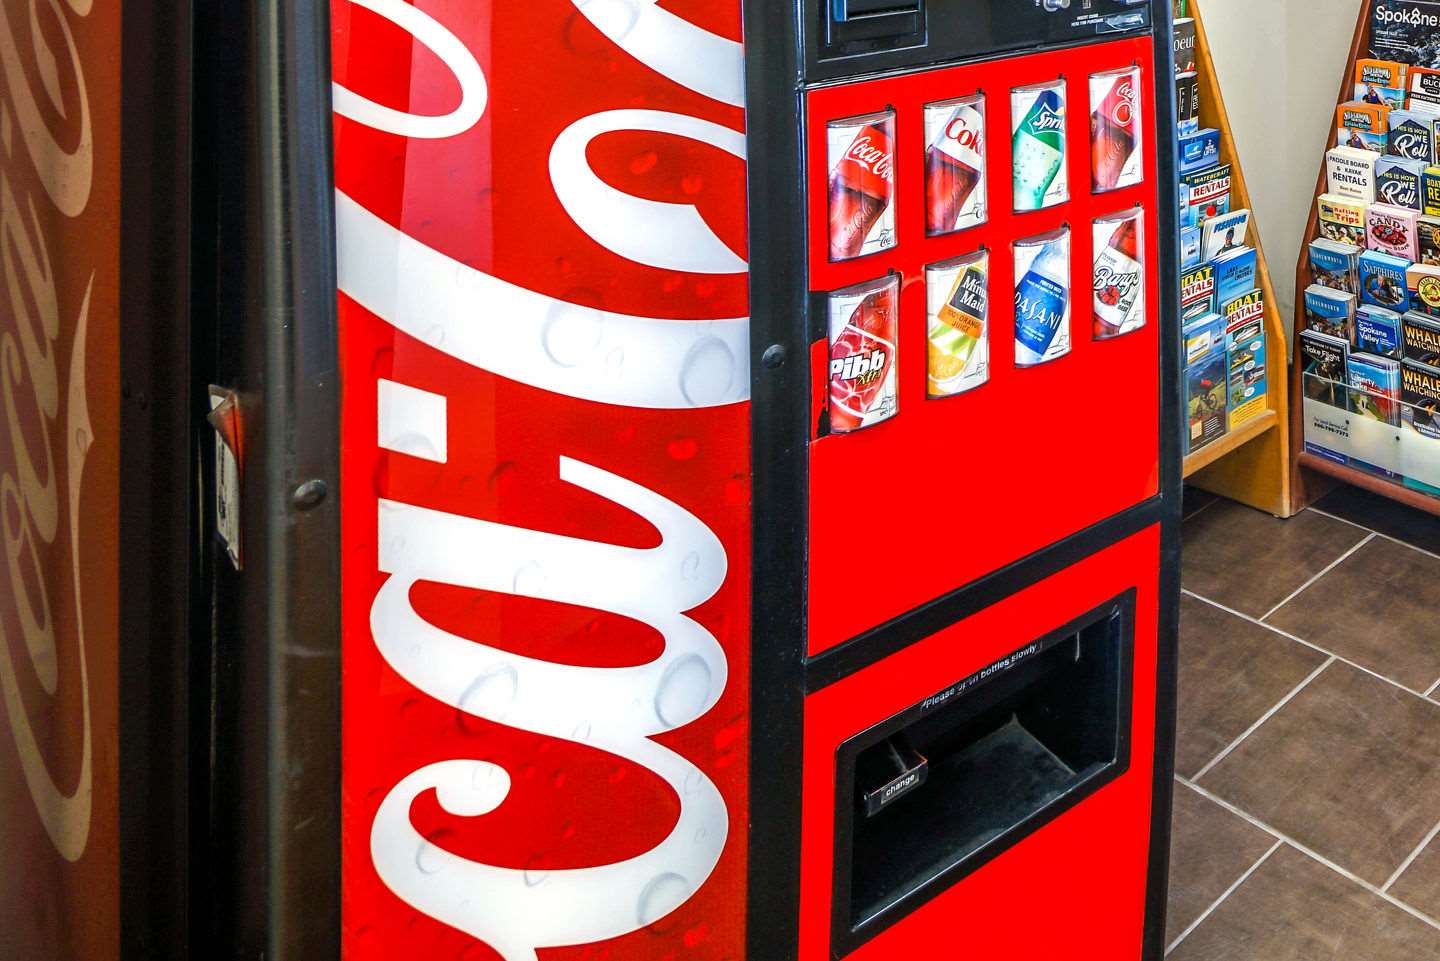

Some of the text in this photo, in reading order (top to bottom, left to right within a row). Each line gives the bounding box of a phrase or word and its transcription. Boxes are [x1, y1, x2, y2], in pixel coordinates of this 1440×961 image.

[1375, 6, 1438, 28] Spokane
[1394, 134, 1428, 160] Roll
[1414, 134, 1428, 143] WE
[1329, 156, 1370, 170] PADDLE BOARD
[1344, 167, 1362, 176] KAYAK
[1193, 176, 1230, 196] RENTALS
[1332, 172, 1367, 187] RENTALS
[1400, 181, 1415, 190] WE
[1426, 178, 1440, 188] BOAT
[1380, 180, 1416, 208] Roll
[1334, 207, 1359, 217] Rafting
[1335, 213, 1360, 225] Trips
[1369, 216, 1409, 232] CANDY
[1363, 261, 1404, 281] SAPPHIRES
[959, 291, 985, 313] Maid
[1226, 292, 1262, 315] BOAT
[1226, 303, 1262, 326] RENTALS
[1358, 323, 1388, 338] Spokane
[1360, 332, 1380, 345] Valley
[1305, 344, 1321, 355] Take
[1321, 348, 1341, 363] Flight
[830, 349, 887, 381] Pibb
[885, 772, 915, 797] change
